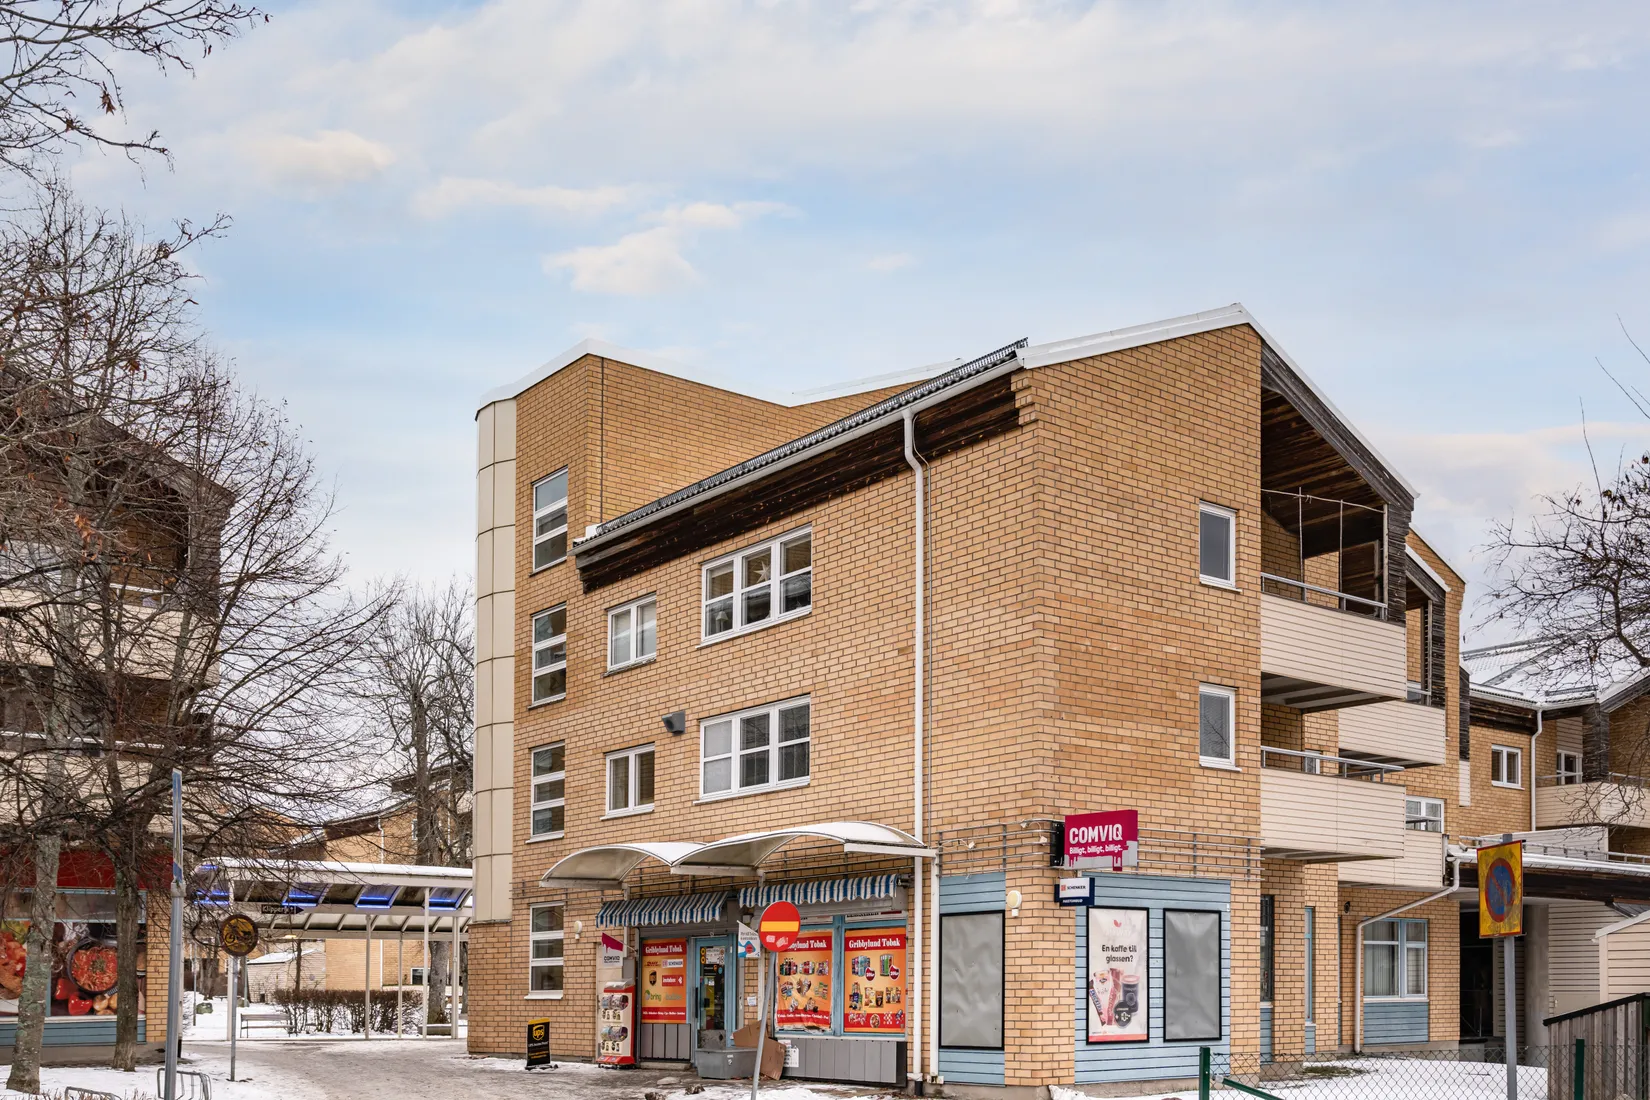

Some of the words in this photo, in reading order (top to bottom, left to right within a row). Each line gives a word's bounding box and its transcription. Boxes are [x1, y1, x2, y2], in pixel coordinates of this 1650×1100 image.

[1069, 823, 1123, 844] COMVIQ
[810, 939, 827, 949] Tobak
[848, 939, 881, 950] Gribbylund
[881, 938, 901, 947] Tobak
[1101, 944, 1110, 952] En
[1110, 944, 1128, 953] kaffe
[1105, 954, 1134, 964] glassen?
